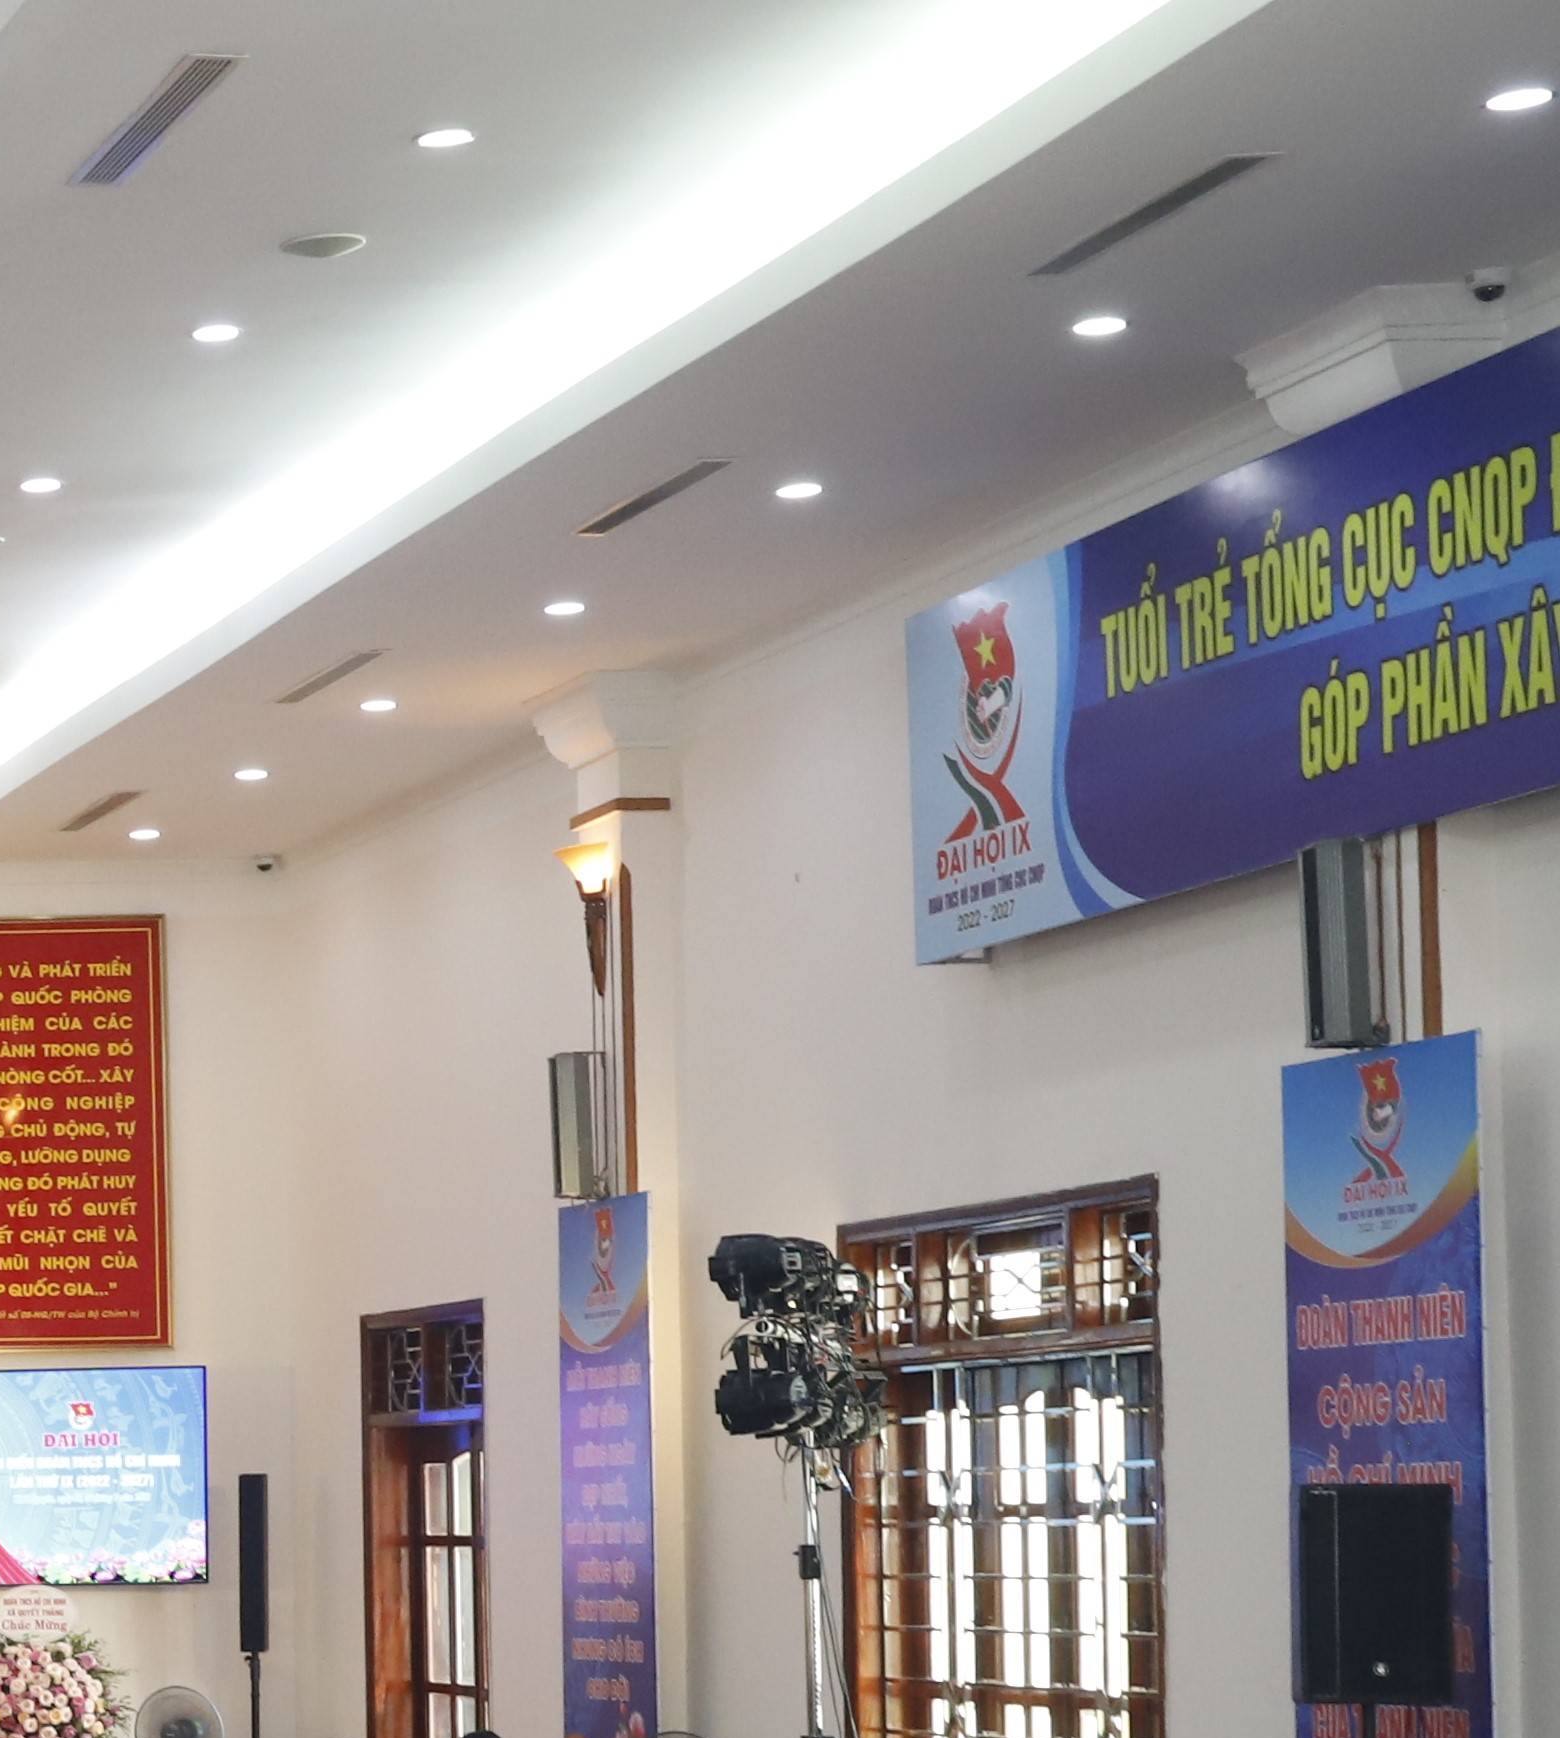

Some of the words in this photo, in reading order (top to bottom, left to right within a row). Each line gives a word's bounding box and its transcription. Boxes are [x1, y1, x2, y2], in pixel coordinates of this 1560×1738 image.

[1100, 563, 1168, 698] TUỔI
[1175, 537, 1234, 671] TRẺ
[1242, 509, 1332, 646] TỔNG
[1341, 493, 1416, 619] CỤC
[1428, 446, 1537, 577] CNQP
[1300, 658, 1370, 780] GÓP
[1382, 606, 1487, 755] PHẦN
[937, 843, 967, 884] ĐẠI
[973, 825, 1006, 873] HỘI
[1012, 821, 1032, 856] IX
[11, 985, 63, 1005] QUỐC
[71, 986, 132, 1003] PHÒNG
[40, 1256, 90, 1273] NHỌN
[101, 1251, 139, 1269] CỦA
[1296, 1295, 1348, 1350] ĐOÀN
[1352, 1295, 1412, 1346] THANH
[1416, 1283, 1467, 1342] NIÊN
[2, 1620, 31, 1631] Chúc
[36, 1619, 68, 1632] Mừng
